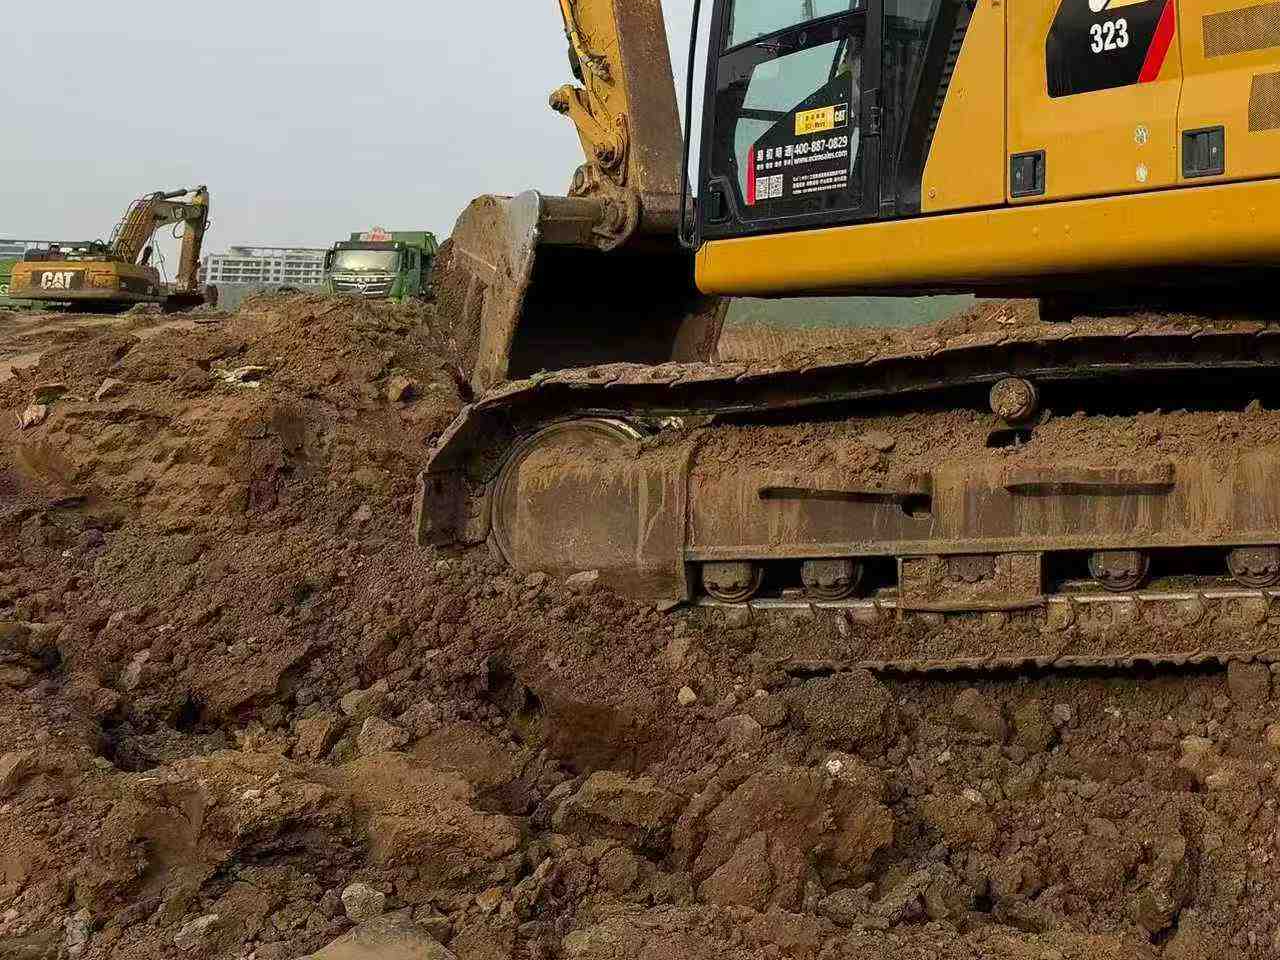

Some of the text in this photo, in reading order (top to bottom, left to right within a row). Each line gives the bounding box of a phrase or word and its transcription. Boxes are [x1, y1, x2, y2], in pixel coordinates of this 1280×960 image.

[1090, 18, 1129, 54] 323
[794, 136, 848, 155] 400-887-0829
[40, 271, 74, 289] CAT
